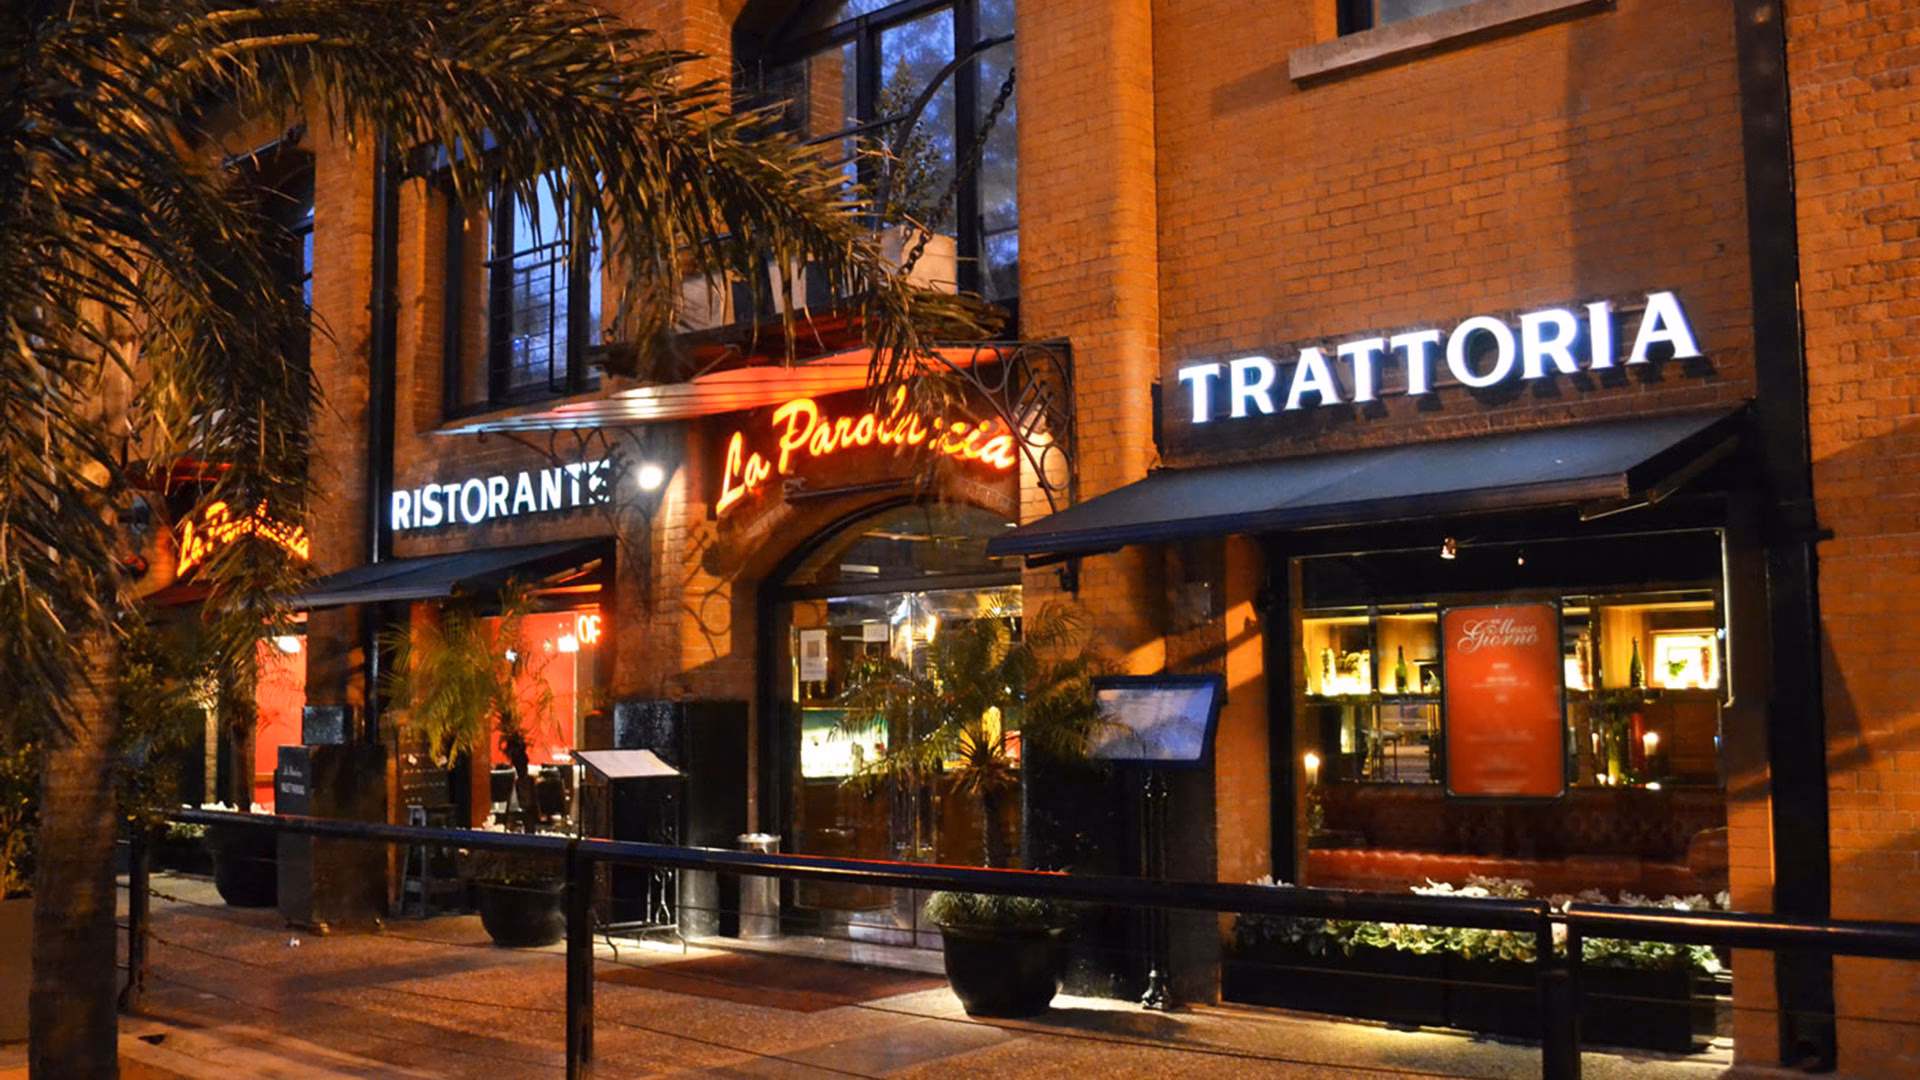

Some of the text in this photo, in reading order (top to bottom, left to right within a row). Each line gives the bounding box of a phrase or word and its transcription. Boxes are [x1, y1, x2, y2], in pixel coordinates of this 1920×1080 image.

[1178, 291, 1701, 424] TRATTORIA
[716, 385, 1015, 514] La Parolacia
